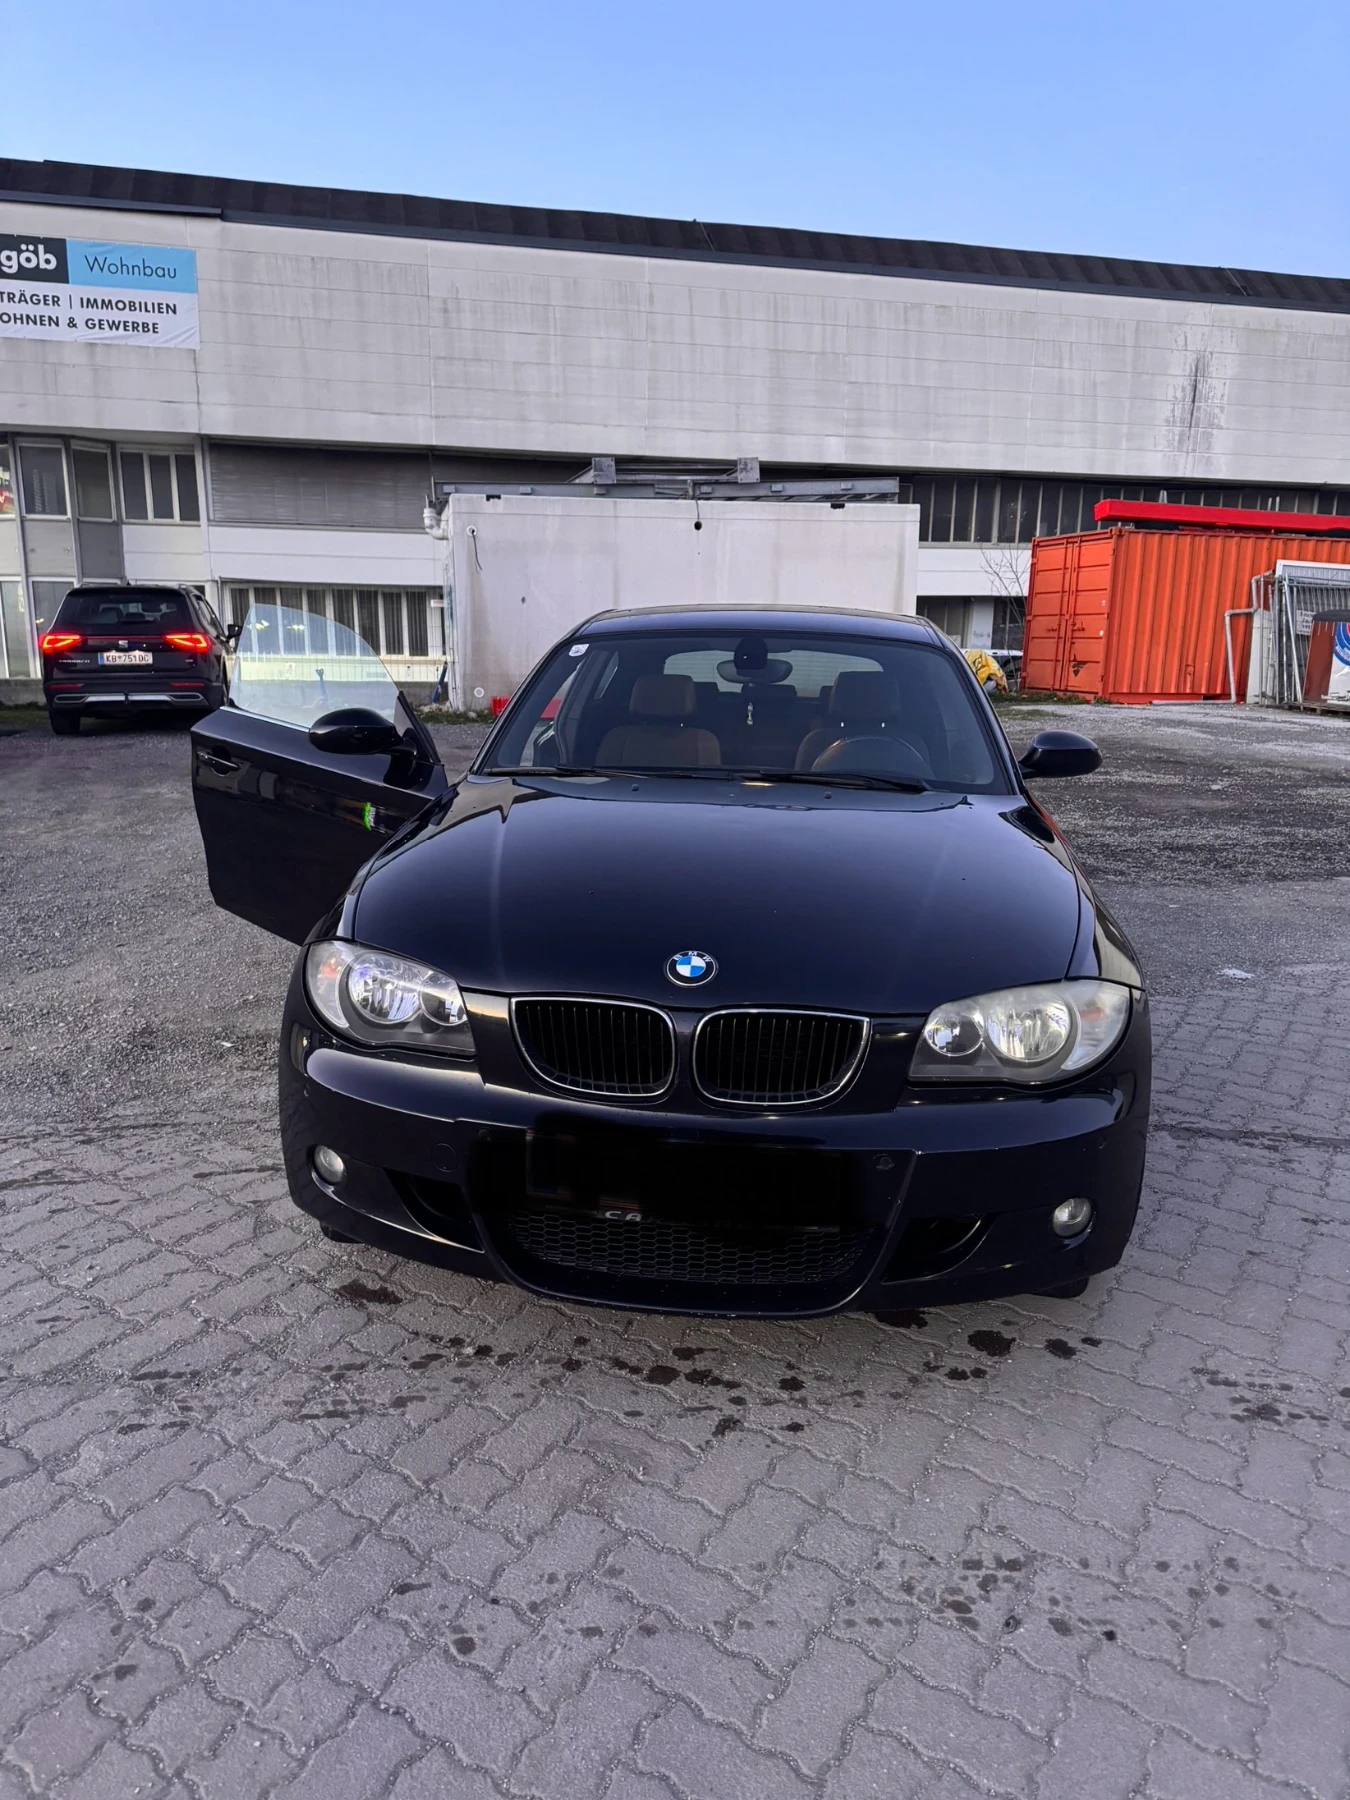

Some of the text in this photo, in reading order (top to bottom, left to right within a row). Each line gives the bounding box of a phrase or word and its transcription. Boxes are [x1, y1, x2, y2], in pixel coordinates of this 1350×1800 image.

[0, 243, 57, 274] göb
[84, 255, 177, 279] Wohnbau
[0, 289, 61, 307] TRÄGER
[80, 296, 177, 315] IMMOBILIEN
[0, 312, 159, 334] OHNEN & GEWERBE
